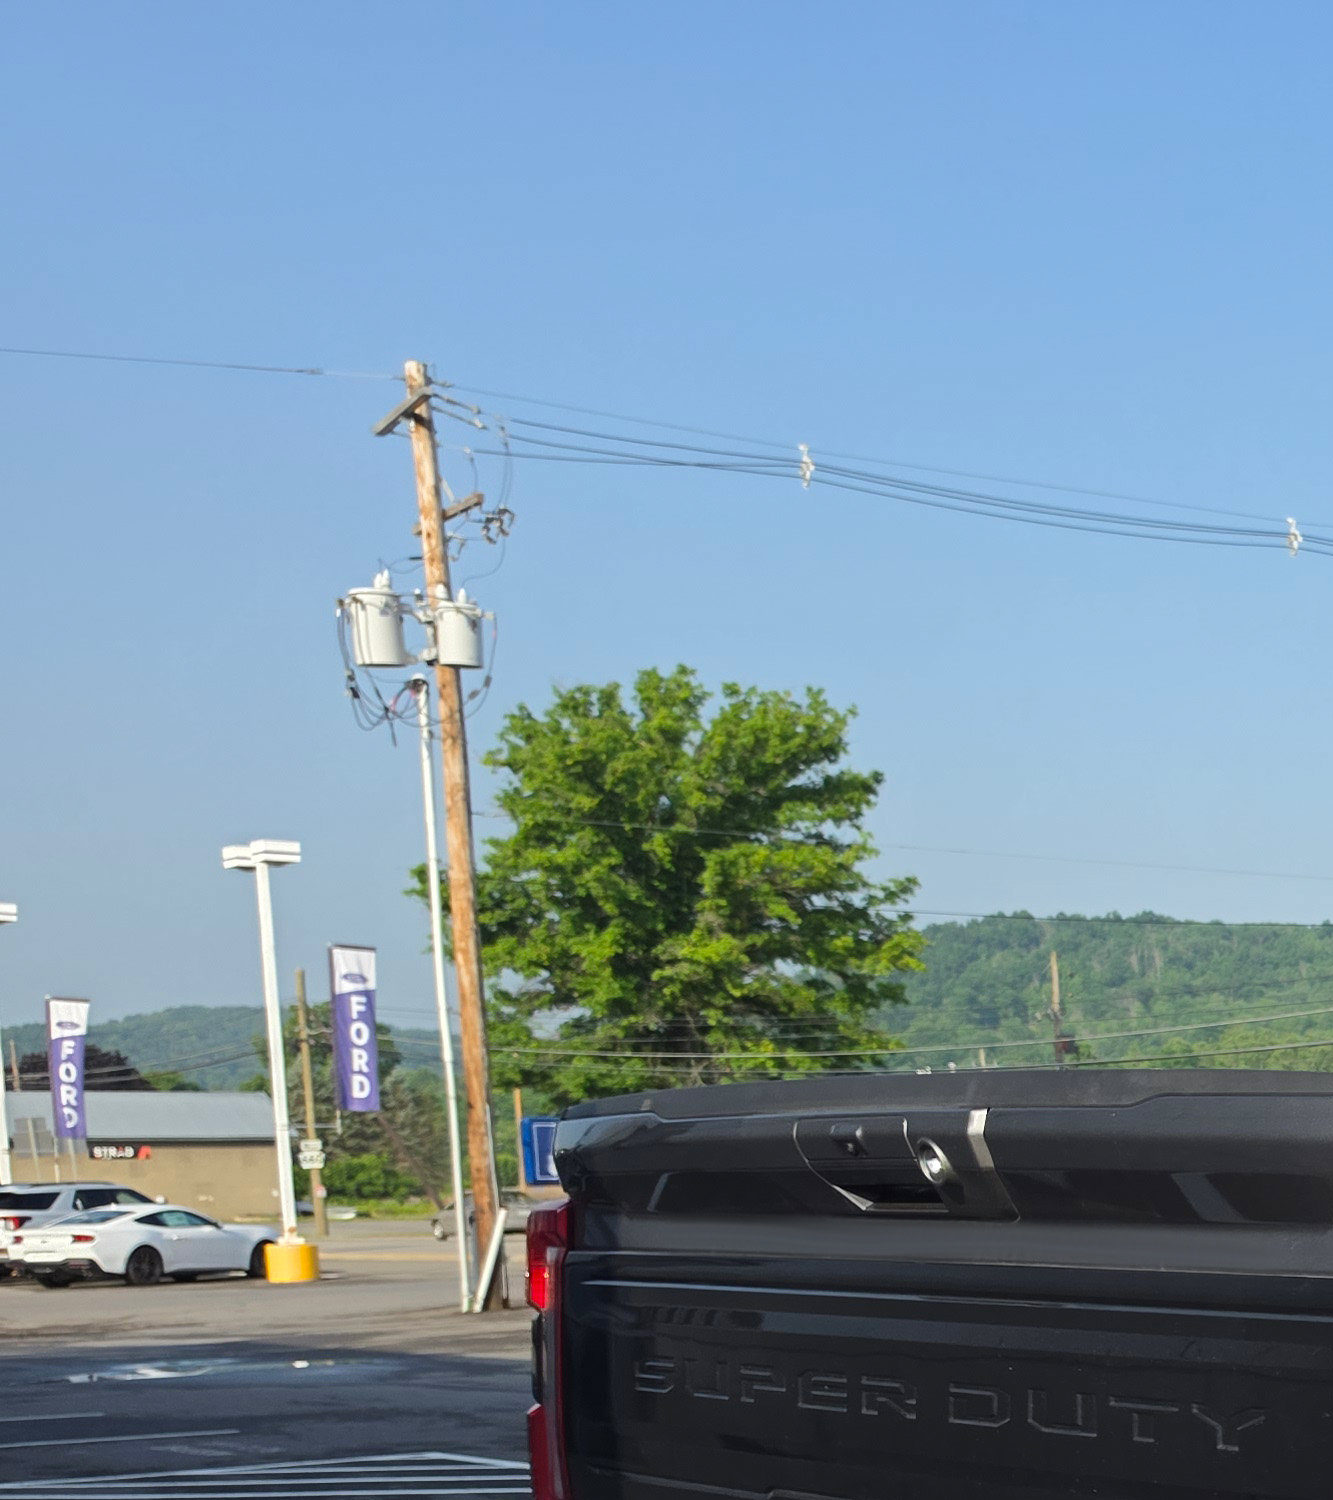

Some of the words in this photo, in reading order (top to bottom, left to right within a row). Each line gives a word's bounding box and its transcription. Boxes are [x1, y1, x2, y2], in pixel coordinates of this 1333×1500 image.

[58, 1039, 79, 1129] FORD
[349, 995, 372, 1099] FORD
[634, 1356, 917, 1420] SUPER
[948, 1382, 1267, 1452] DUTY
